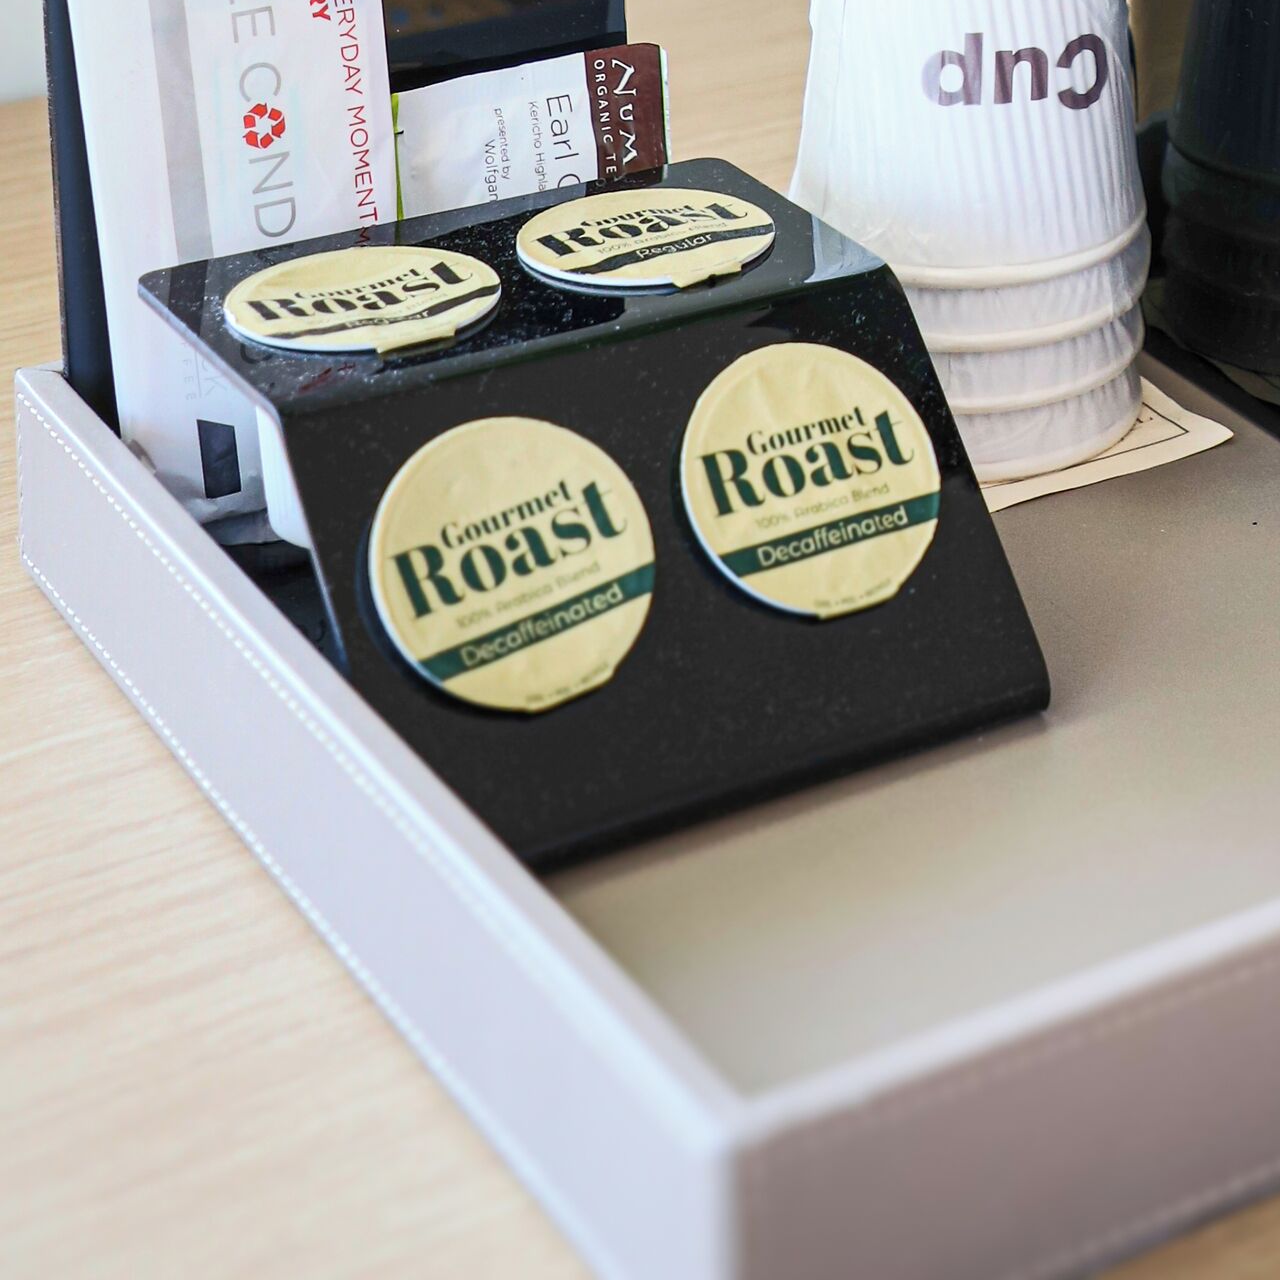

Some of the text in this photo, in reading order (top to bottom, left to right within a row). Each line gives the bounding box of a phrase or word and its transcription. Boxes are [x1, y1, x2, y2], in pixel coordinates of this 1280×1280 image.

[528, 100, 544, 149] Kericho
[546, 94, 580, 161] Earl
[592, 58, 614, 144] ORGANIC
[494, 107, 511, 180] presented by
[536, 202, 748, 257] Roast
[582, 204, 696, 229] Gourmet
[635, 233, 713, 259] Regular
[247, 260, 474, 321] Roast
[294, 268, 425, 300] Gourmet
[746, 405, 867, 457] Gourmet
[697, 408, 915, 518] Roast
[440, 479, 572, 549] Gourmet
[756, 506, 909, 567] Decaffeinated
[392, 480, 628, 619] Roast
[459, 583, 624, 667] Decaffeinated
